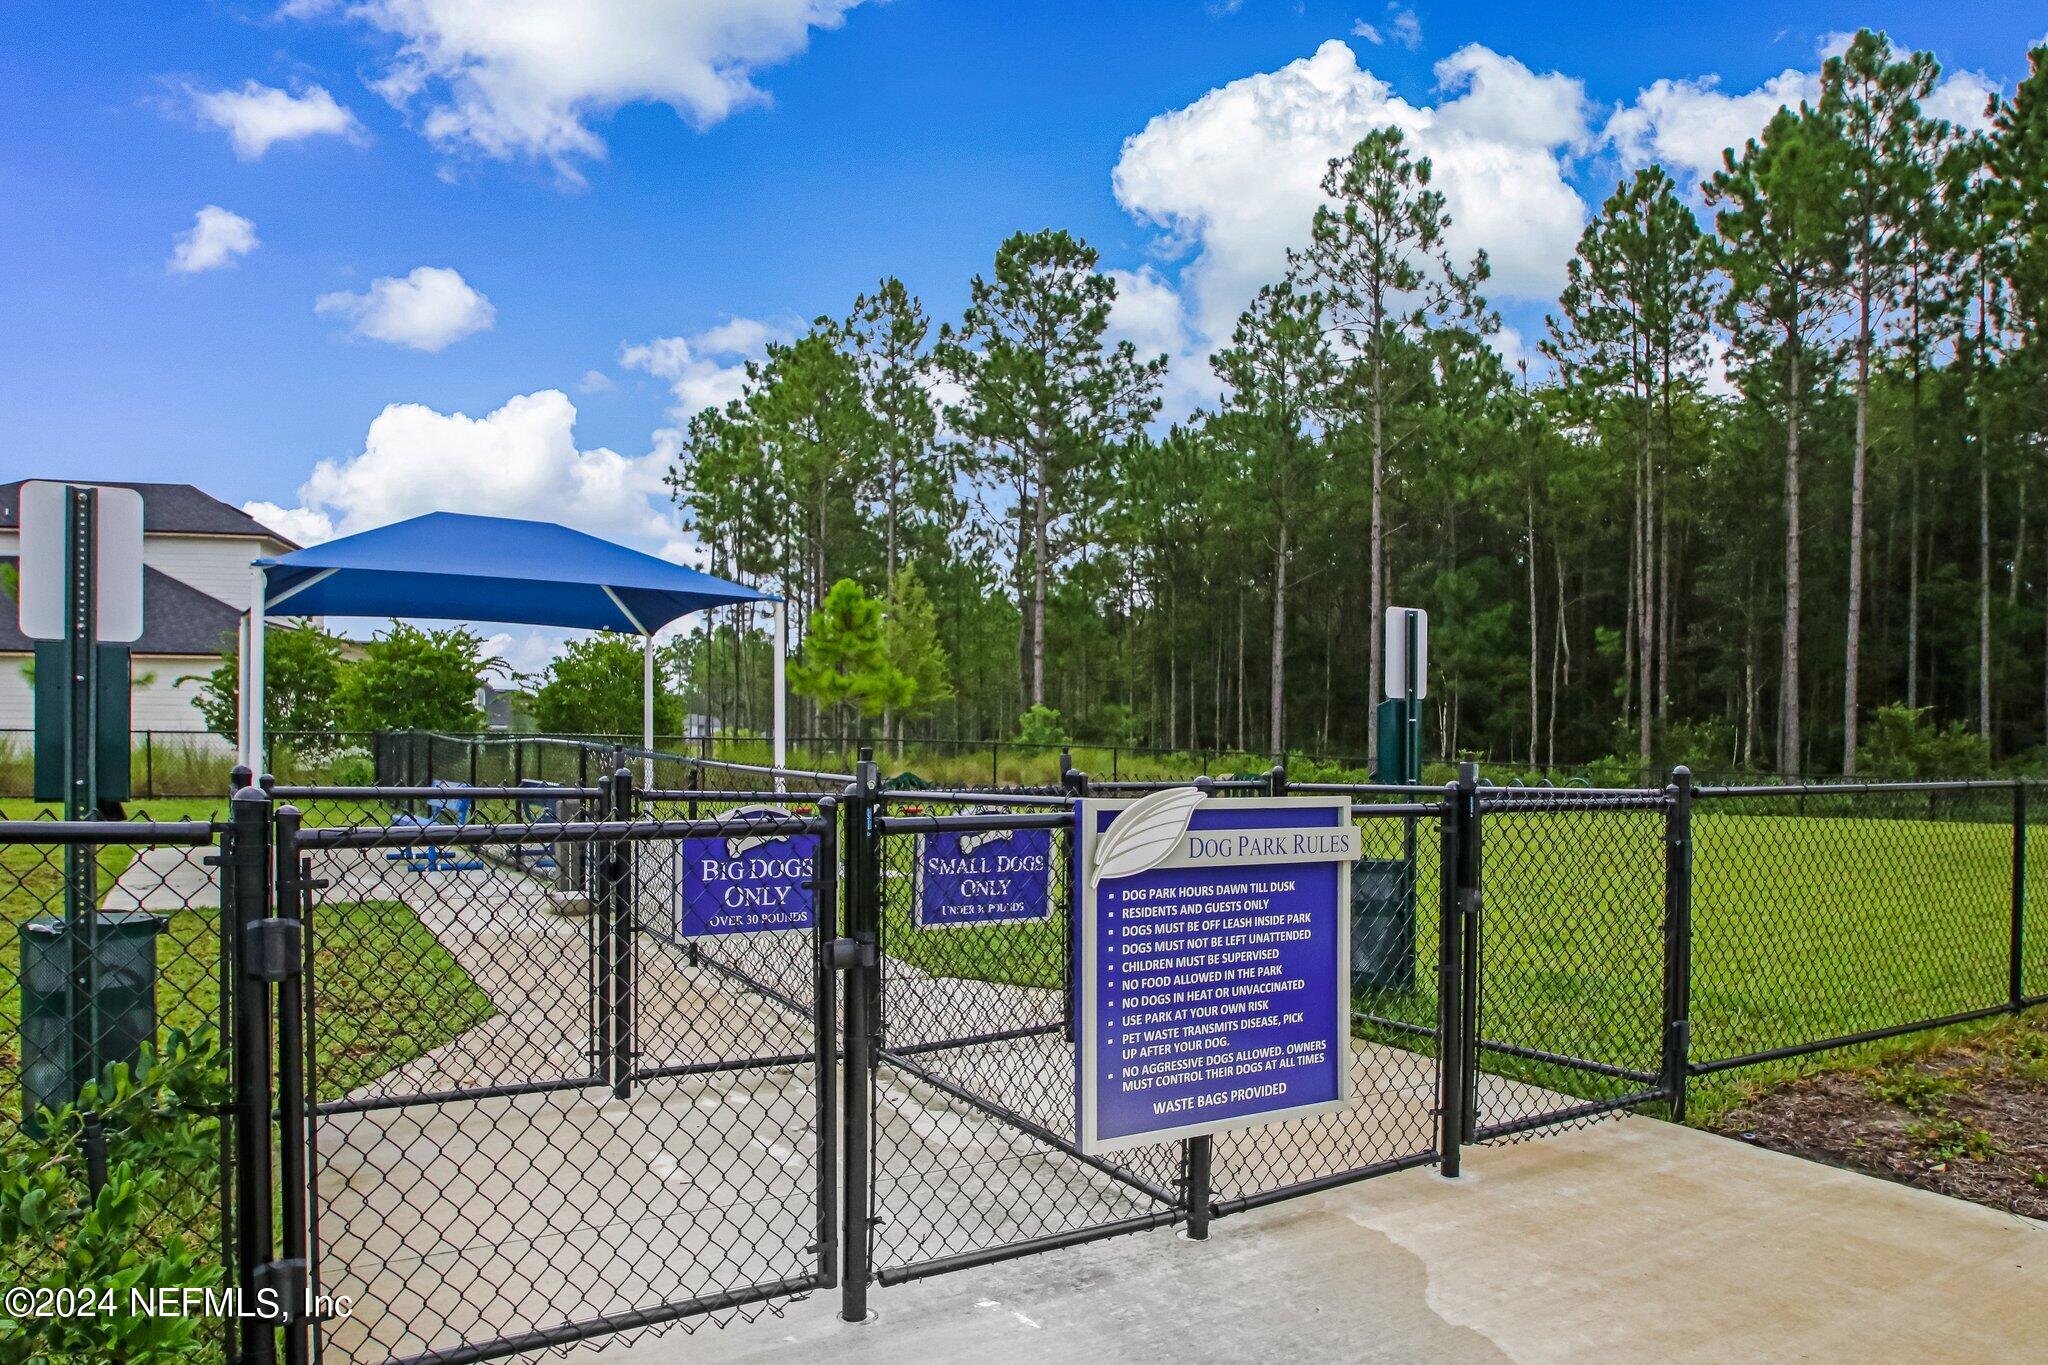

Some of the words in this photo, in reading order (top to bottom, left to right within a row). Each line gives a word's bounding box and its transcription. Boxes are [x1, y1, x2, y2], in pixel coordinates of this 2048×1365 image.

[1189, 837, 1232, 858] DOG
[1238, 836, 1288, 857] PARK
[1293, 834, 1349, 854] RULES
[701, 860, 744, 881] BIG
[749, 858, 813, 879] DOGS
[928, 857, 991, 875] SMALL
[997, 856, 1044, 873] DOGS
[724, 886, 792, 908] ONLY
[960, 880, 1011, 897] ONLY
[1122, 889, 1146, 901] DOG
[1149, 887, 1176, 899] PARK
[1179, 885, 1214, 898] HOURS
[1216, 884, 1248, 896] DAWN
[1250, 882, 1268, 893] TILL
[1270, 881, 1295, 892] DUSK
[709, 916, 744, 927] OVER
[746, 915, 759, 924] 30
[761, 912, 808, 924] POUNDS
[1122, 905, 1177, 919] RESIDENTS
[1180, 903, 1202, 915] AND
[1205, 901, 1241, 913] GUESTS
[1244, 899, 1269, 910] ONLY
[1122, 924, 1152, 937] DOGS
[1154, 922, 1185, 934] MUST
[1187, 921, 1200, 932] BE
[1202, 919, 1220, 931] OFF
[1222, 917, 1252, 929] LEASH
[1254, 914, 1285, 927] INSIDE
[1287, 912, 1311, 924] PARK
[1122, 942, 1152, 955] DOGS
[1154, 940, 1185, 952] MUST
[1187, 938, 1209, 949] NOT
[1211, 937, 1223, 948] BE
[1225, 934, 1247, 946] LEFT
[1249, 930, 1311, 944] UNATTENDED
[1122, 958, 1173, 973] CHILDREN
[1176, 955, 1205, 968] MUST
[1208, 954, 1220, 965] BE
[1222, 948, 1279, 964] SUPERVISED
[1122, 979, 1139, 991] NO
[1141, 976, 1171, 988] FOOD
[1173, 971, 1222, 985] ALLOWED
[1224, 969, 1235, 980] IN
[1237, 967, 1255, 979] THE
[1257, 964, 1283, 977] PARK
[1122, 997, 1139, 1009] NO
[1141, 993, 1171, 1006] DOGS
[1173, 992, 1184, 1003] IN
[1187, 989, 1213, 1002] HEAT
[1215, 987, 1229, 998] OR
[1232, 979, 1305, 997] UNVACCINATED
[1122, 1014, 1142, 1026] USE
[1145, 1010, 1172, 1024] PARK
[1174, 1009, 1188, 1020] AT
[1190, 1006, 1218, 1018] YOUR
[1220, 1002, 1246, 1015] OWN
[1248, 1000, 1269, 1012] RISK
[1122, 1032, 1141, 1044] PET
[1144, 1028, 1180, 1042] WASTE
[1182, 1020, 1238, 1037] TRANSMITS
[1240, 1015, 1281, 1030] DISEASE,
[1283, 1012, 1304, 1024] PICK
[1122, 1048, 1137, 1060] UP
[1140, 1044, 1171, 1058] AFTER
[1174, 1040, 1202, 1053] YOUR
[1205, 1036, 1230, 1049] DOG.
[1122, 1066, 1139, 1078] NO
[1141, 1056, 1204, 1075] AGGRESSIVE
[1206, 1052, 1234, 1066] DOGS
[1236, 1046, 1284, 1061] ALLOWED.
[1286, 1040, 1326, 1054] OWNERS
[1122, 1078, 1153, 1092] MUST
[1156, 1070, 1203, 1087] CONTROL
[1206, 1066, 1234, 1079] THEIR
[1236, 1062, 1263, 1075] DOGS
[1265, 1059, 1277, 1071] AT
[1279, 1058, 1295, 1068] ALL
[1297, 1053, 1325, 1066] TIMES
[1153, 1097, 1194, 1115] WASTE
[1197, 1091, 1228, 1107] BAGS
[1231, 1082, 1287, 1102] PROVIDED
